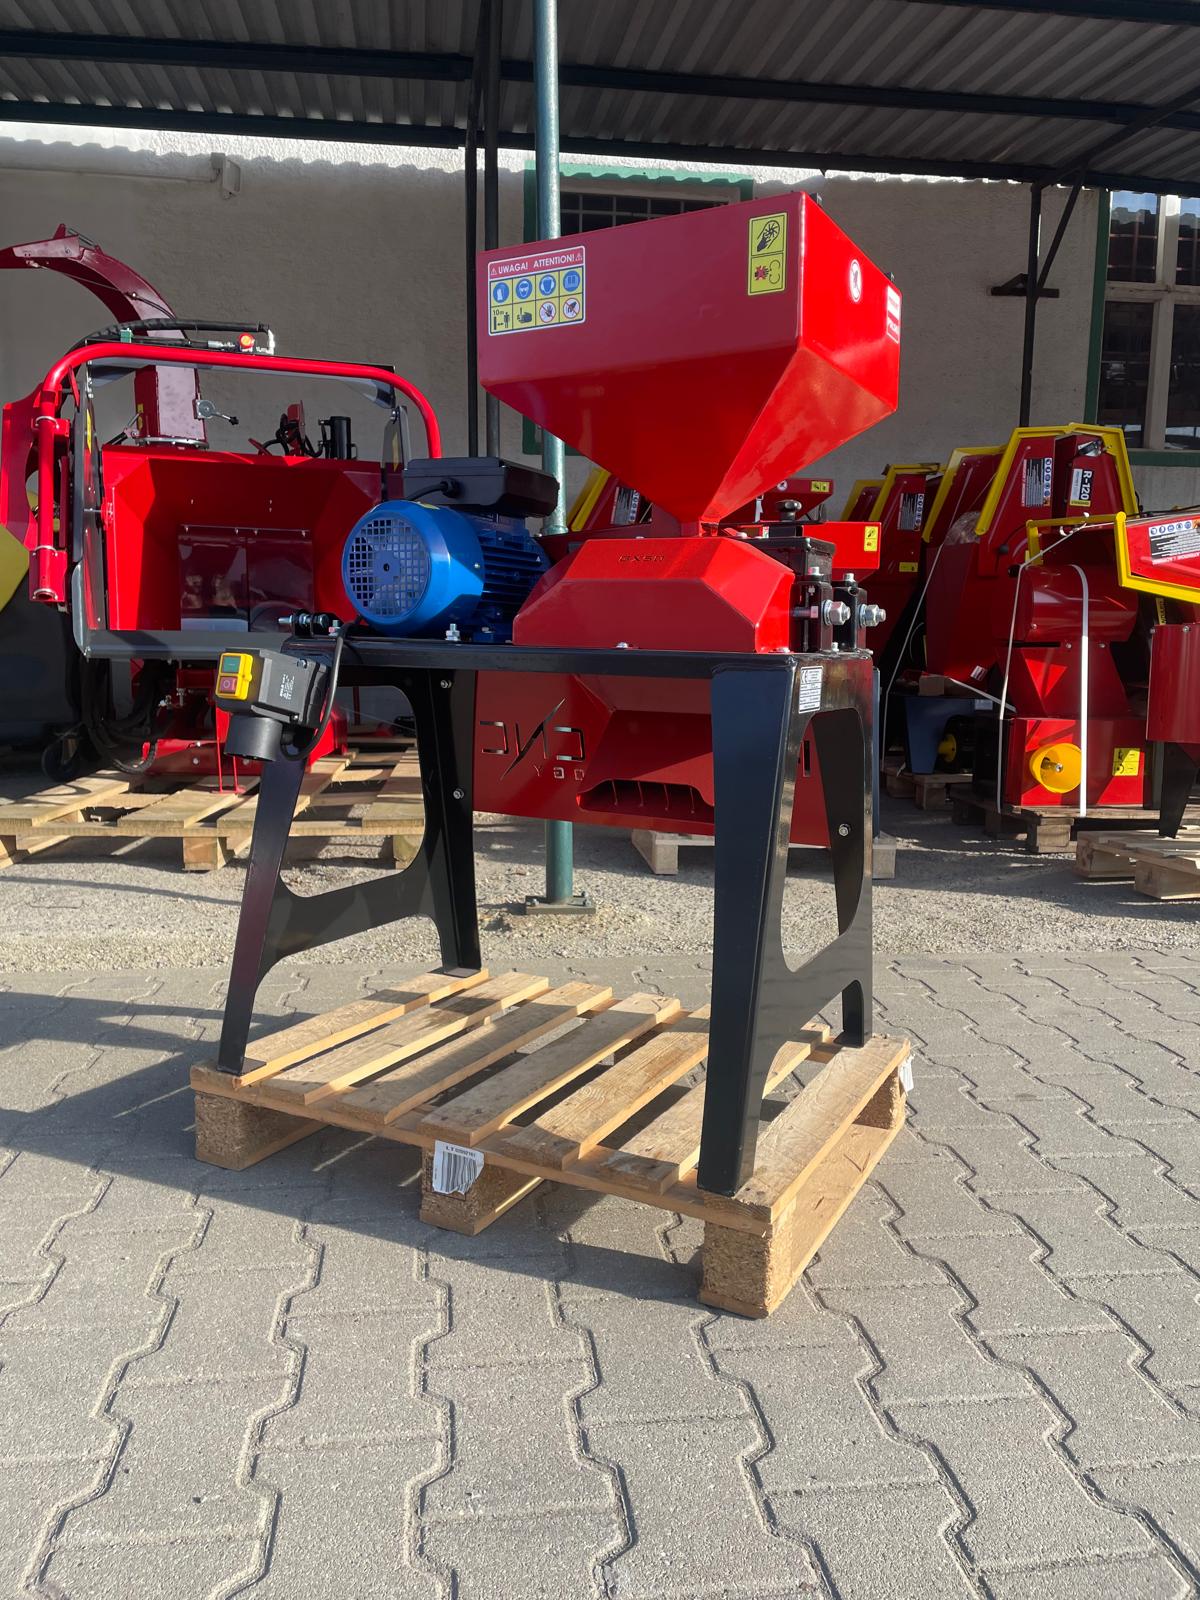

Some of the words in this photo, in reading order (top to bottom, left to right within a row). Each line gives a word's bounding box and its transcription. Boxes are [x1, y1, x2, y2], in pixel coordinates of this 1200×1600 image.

[498, 263, 529, 274] UWAGA!
[533, 255, 575, 269] ATTENTION!
[1080, 470, 1093, 500] R-120
